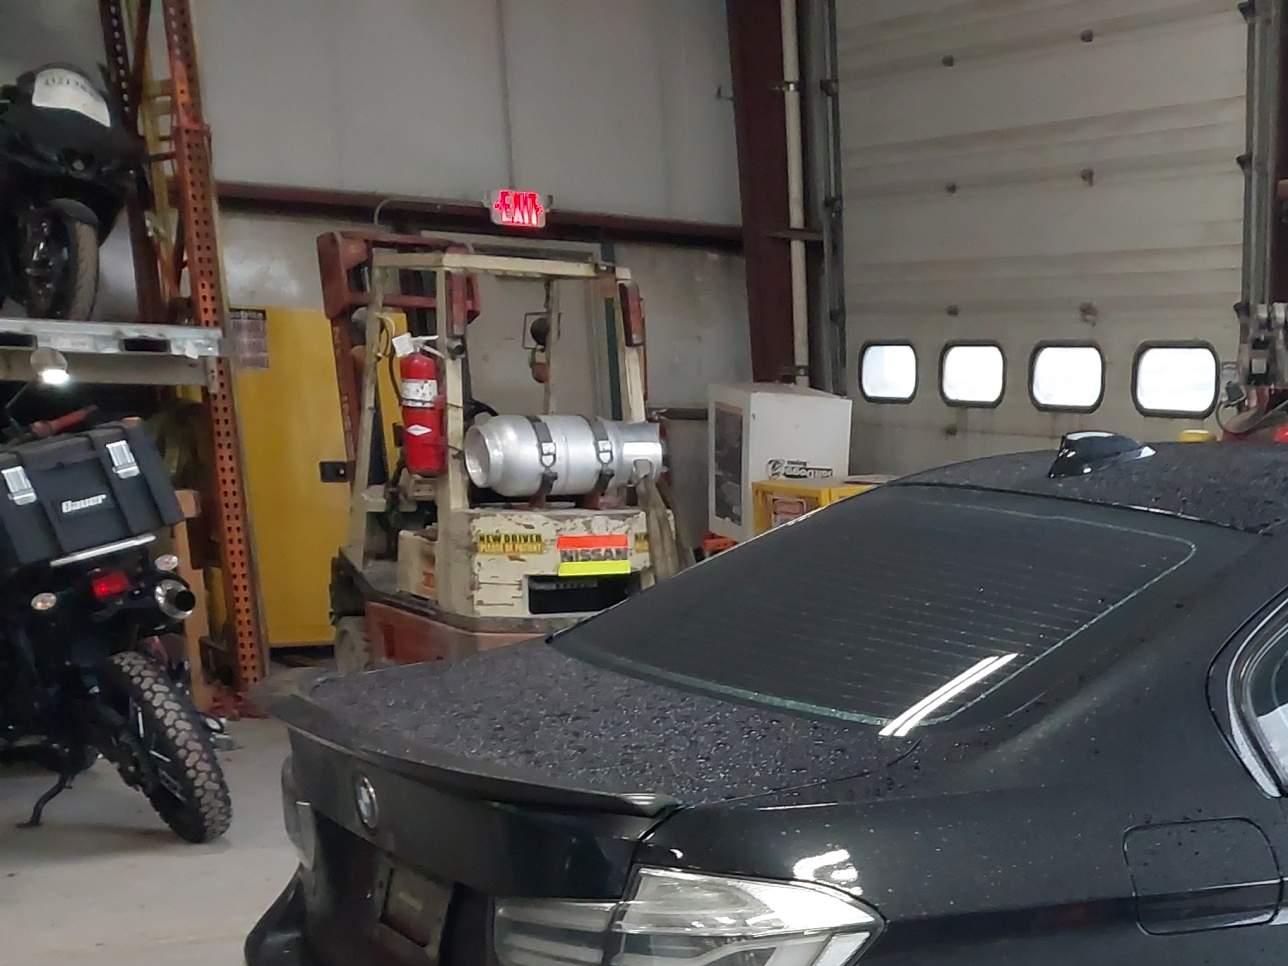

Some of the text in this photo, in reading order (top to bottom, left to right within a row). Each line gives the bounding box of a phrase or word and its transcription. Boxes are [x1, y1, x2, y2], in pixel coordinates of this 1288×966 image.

[500, 191, 537, 225] EXIT
[504, 533, 542, 543] DRIVER
[560, 548, 628, 562] NISSAN
